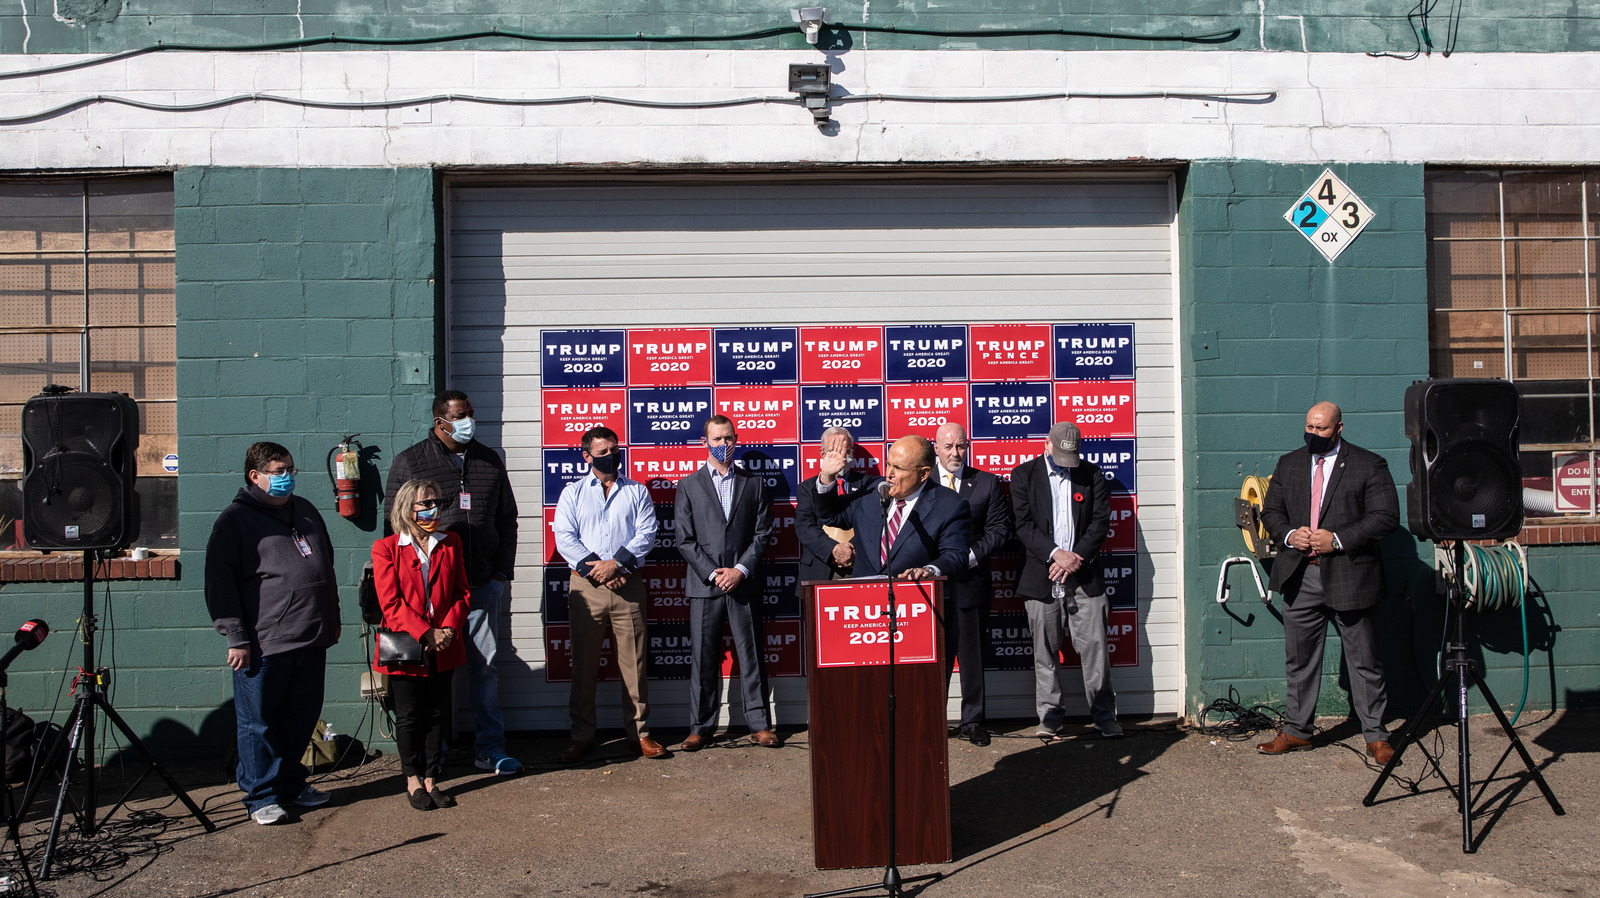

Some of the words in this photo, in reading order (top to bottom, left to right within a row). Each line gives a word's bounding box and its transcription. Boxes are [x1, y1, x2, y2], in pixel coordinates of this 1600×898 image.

[1318, 178, 1336, 205] 4
[1299, 201, 1318, 228] 2
[1342, 202, 1360, 229] 3
[1321, 232, 1338, 243] OX
[633, 343, 707, 354] TRUMP
[719, 342, 792, 353] TRUMP
[805, 341, 877, 352] TRUMP
[890, 340, 962, 351] TRUMP
[976, 340, 1045, 351] TRUMP
[1058, 337, 1129, 349] TRUMP
[546, 344, 620, 356] TRUMP
[736, 361, 776, 370] 2020
[822, 360, 861, 369] 2020
[907, 358, 945, 367] 2020
[1075, 356, 1113, 365] 2020
[564, 363, 604, 372] 2020
[650, 362, 690, 371] 2020
[720, 400, 793, 412] TRUMP
[806, 399, 878, 410] TRUMP
[890, 398, 962, 409] TRUMP
[975, 396, 1046, 408] TRUMP
[1059, 395, 1130, 406] TRUMP
[547, 403, 621, 415] TRUMP
[634, 402, 707, 413] TRUMP
[737, 419, 776, 428] 2020
[822, 418, 861, 427] 2020
[907, 416, 946, 426] 2020
[992, 415, 1030, 424] 2020
[1075, 414, 1114, 423] 2020
[651, 421, 690, 430] 2020
[806, 457, 879, 469] TMP
[975, 454, 1042, 466] TRUM
[1079, 453, 1130, 464] UMP
[734, 459, 794, 470] RUMP
[652, 479, 678, 488] 202
[654, 538, 678, 547] 202
[763, 594, 778, 604] 20
[824, 603, 927, 621] TRUMP
[850, 631, 904, 644] 2020
[992, 627, 1031, 639] RUM
[650, 636, 692, 648] RUM
[722, 634, 795, 646] TMP
[996, 646, 1034, 656] 2020
[764, 653, 779, 662] 20
